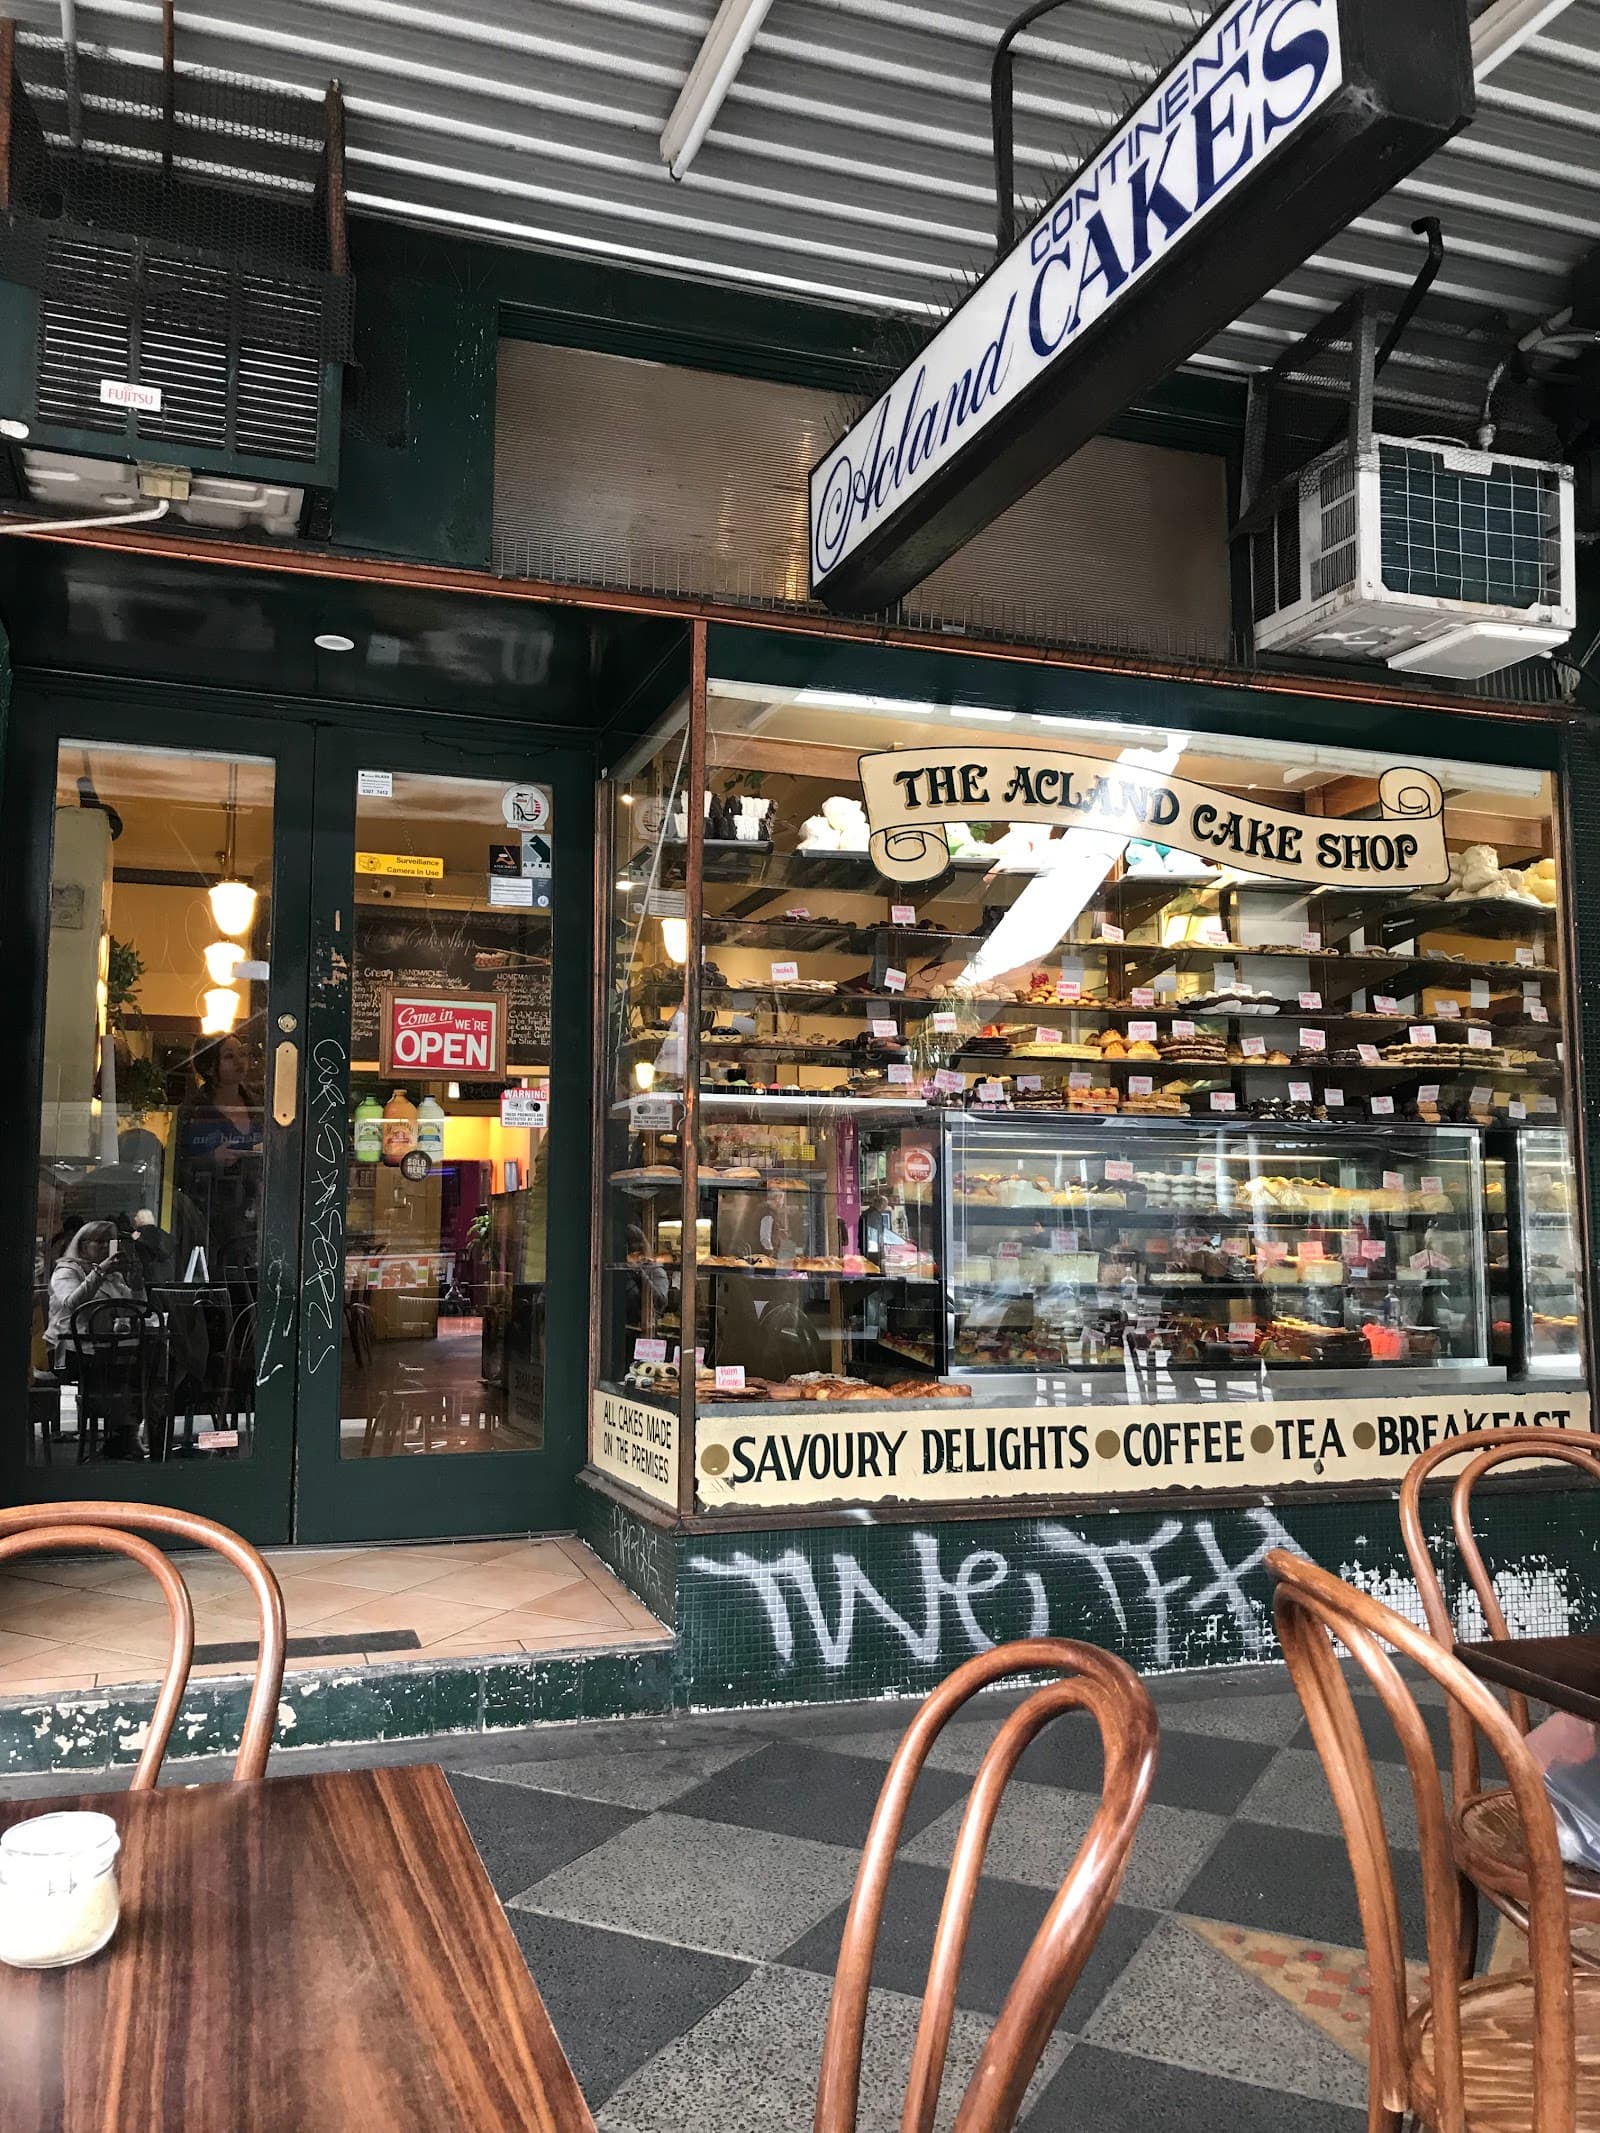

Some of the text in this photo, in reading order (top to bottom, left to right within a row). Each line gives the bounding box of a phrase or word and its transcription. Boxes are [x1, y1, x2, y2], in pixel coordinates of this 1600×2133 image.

[815, 0, 1330, 573] Acland CAKES
[108, 387, 154, 405] FUJITSU
[895, 763, 1420, 873] THE ACLAND CAKE SHOP
[386, 866, 440, 877] Camera in Use
[396, 856, 440, 867] Surveillance
[397, 1007, 437, 1026] Come
[440, 1008, 454, 1022] in
[455, 1017, 488, 1032] WE'RE
[395, 1029, 488, 1067] OPEN
[503, 1089, 546, 1100] WARNING
[407, 1158, 427, 1167] SOLD
[407, 1166, 426, 1176] HERE
[603, 1399, 672, 1450] ALL CAKES MADE
[603, 1431, 669, 1485] ON THE PREMISES
[732, 1430, 908, 1483] SAVOURY
[921, 1425, 1090, 1475] DELIGHTS
[1123, 1420, 1245, 1467] COFFEE
[1276, 1417, 1346, 1460] TEA
